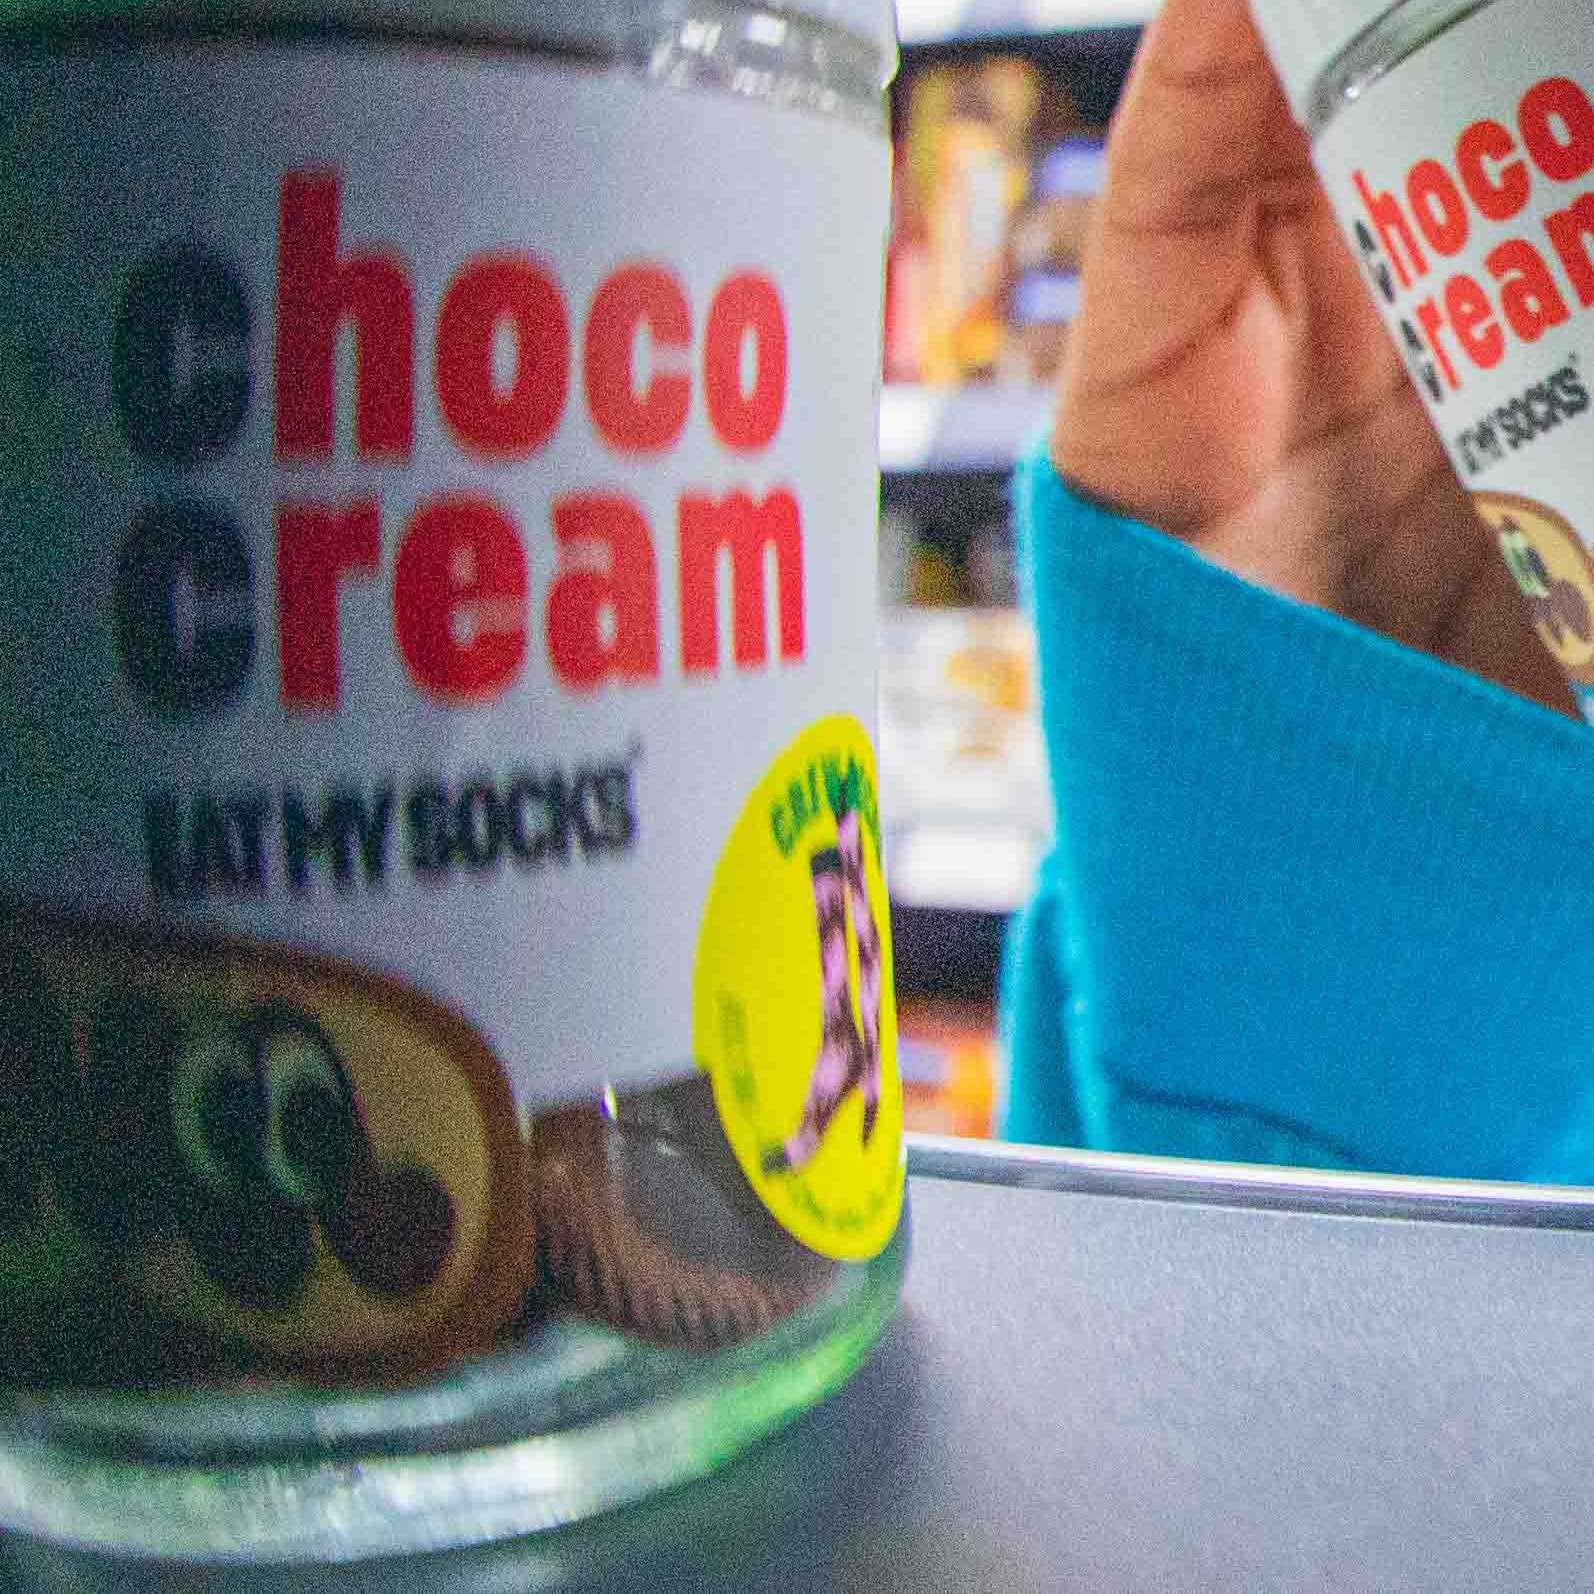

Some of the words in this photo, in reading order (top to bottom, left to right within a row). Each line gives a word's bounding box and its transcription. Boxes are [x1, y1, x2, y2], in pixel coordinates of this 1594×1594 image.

[115, 166, 788, 463] choco
[115, 484, 804, 724] cream
[407, 759, 638, 879] SOCKS
